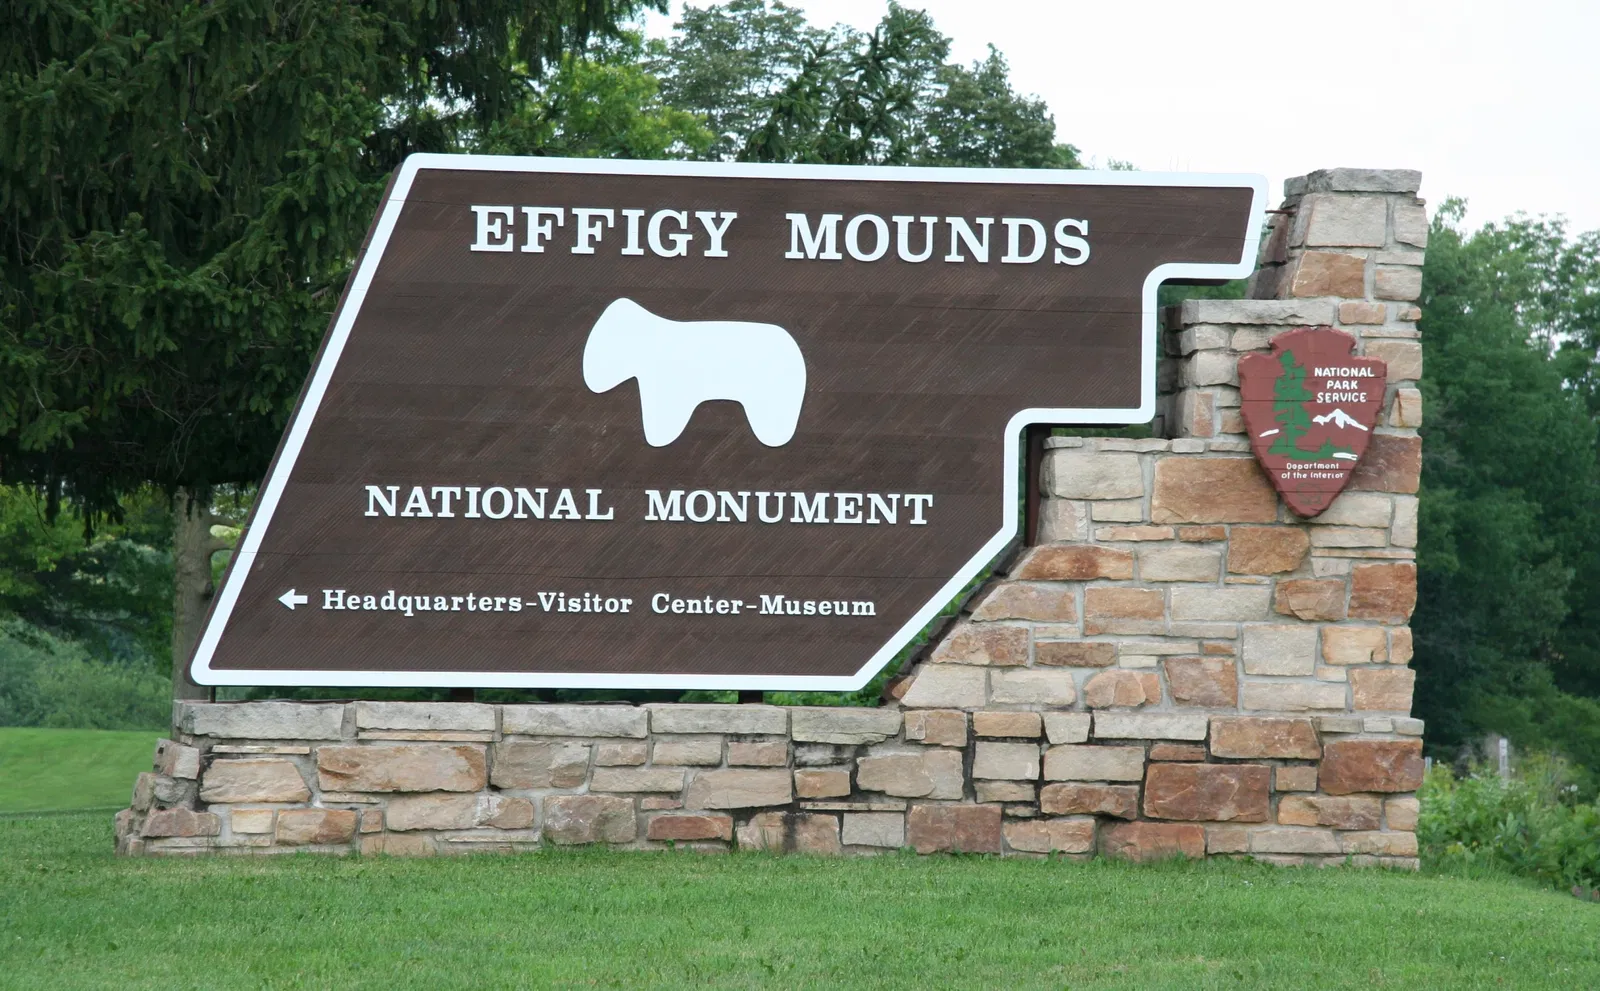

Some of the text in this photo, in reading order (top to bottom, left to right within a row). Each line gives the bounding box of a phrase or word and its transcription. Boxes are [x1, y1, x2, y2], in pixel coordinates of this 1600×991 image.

[471, 206, 1091, 266] EFFIGY MOUNDS
[1314, 367, 1375, 378] NATIONAL
[1326, 380, 1358, 390] PARK
[1316, 392, 1367, 403] SERVICE
[1286, 462, 1339, 471] Department
[365, 486, 934, 525] NATIONAL MONUMENT
